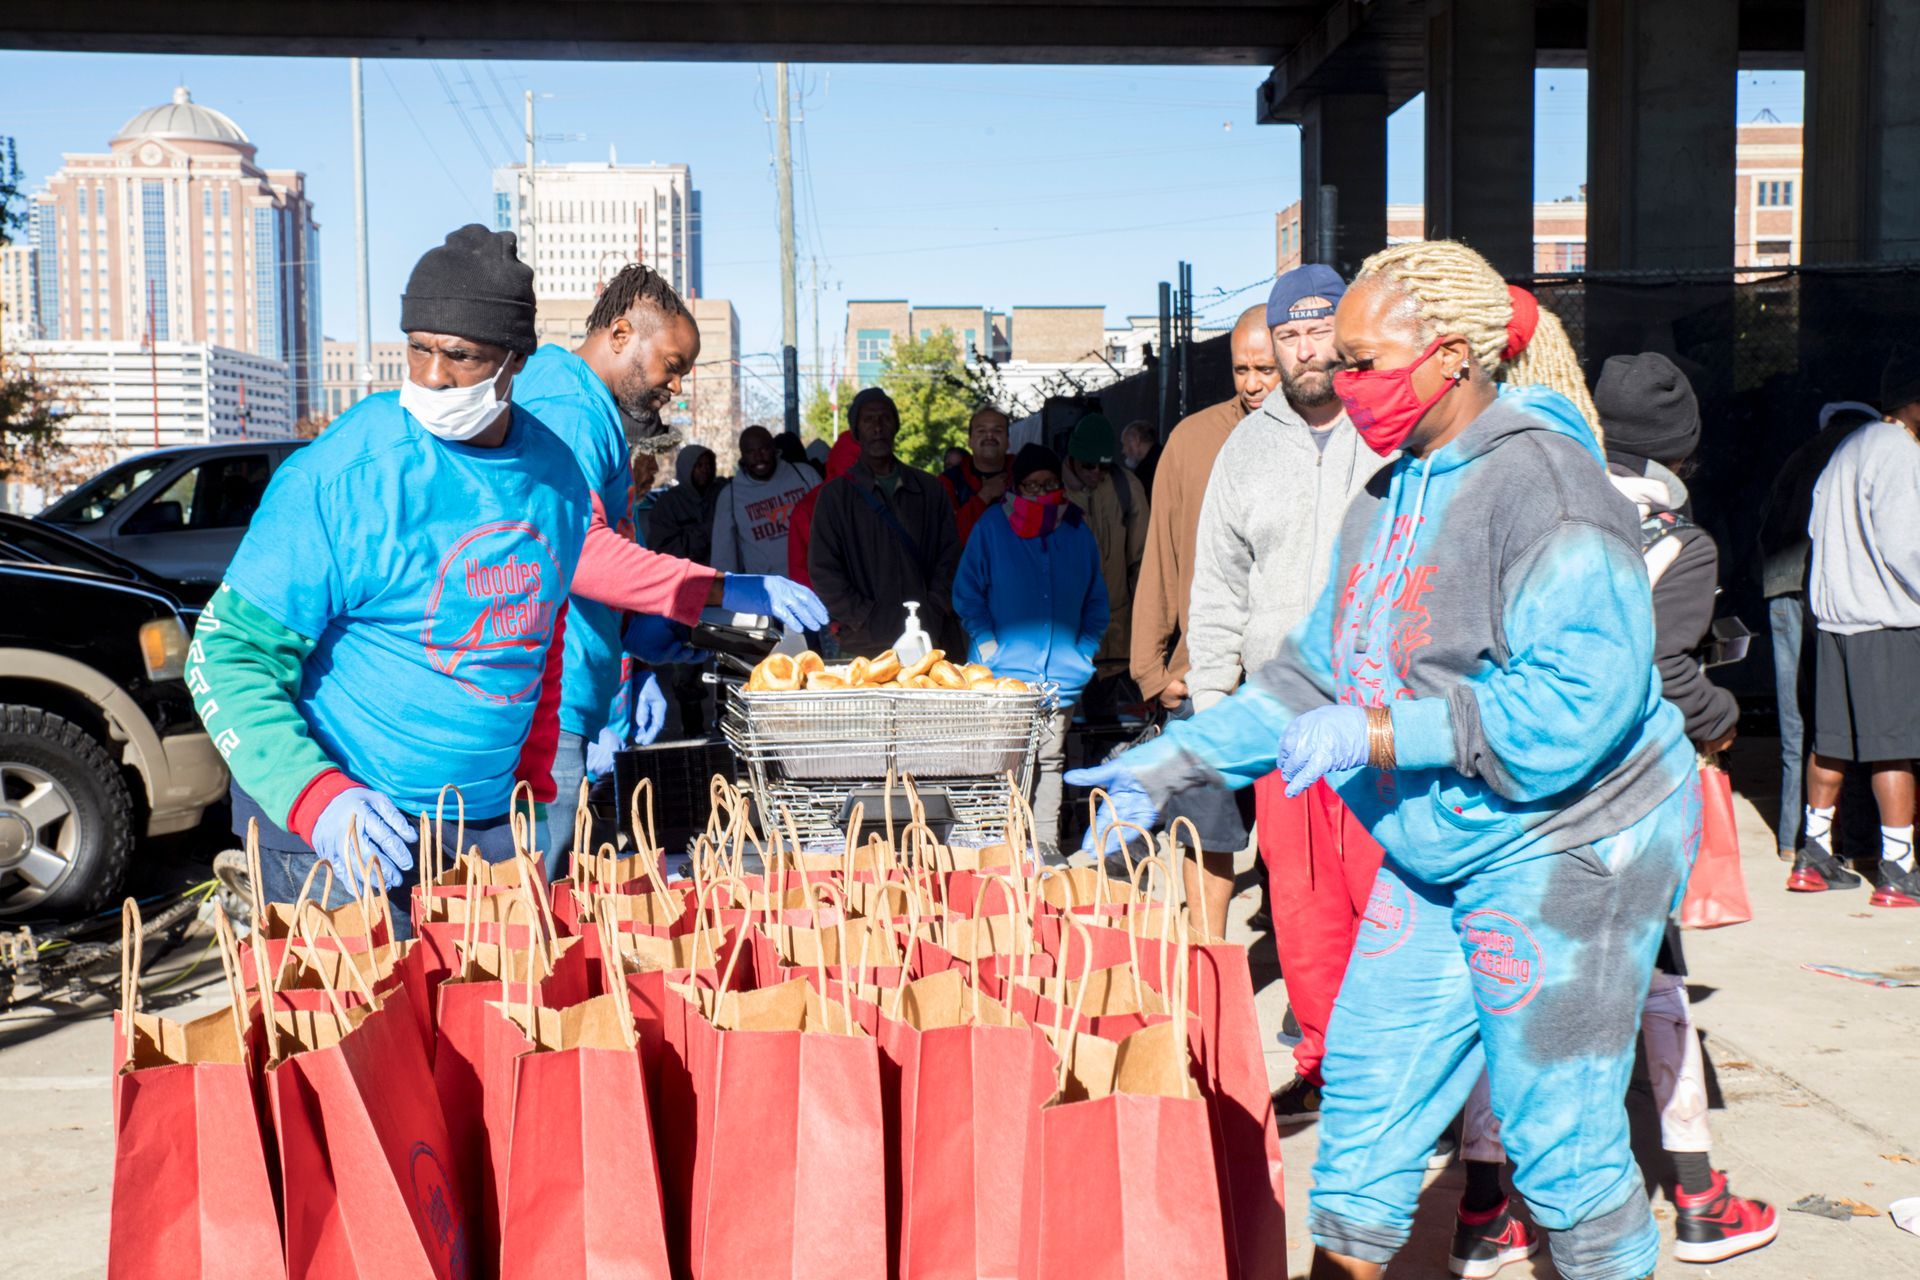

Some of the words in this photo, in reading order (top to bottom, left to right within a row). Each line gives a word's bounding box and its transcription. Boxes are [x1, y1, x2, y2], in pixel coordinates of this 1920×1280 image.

[1289, 310, 1319, 319] TEXAS
[745, 496, 784, 521] VIRGINIA
[752, 518, 790, 540] HOK
[465, 555, 541, 597] Hoodies
